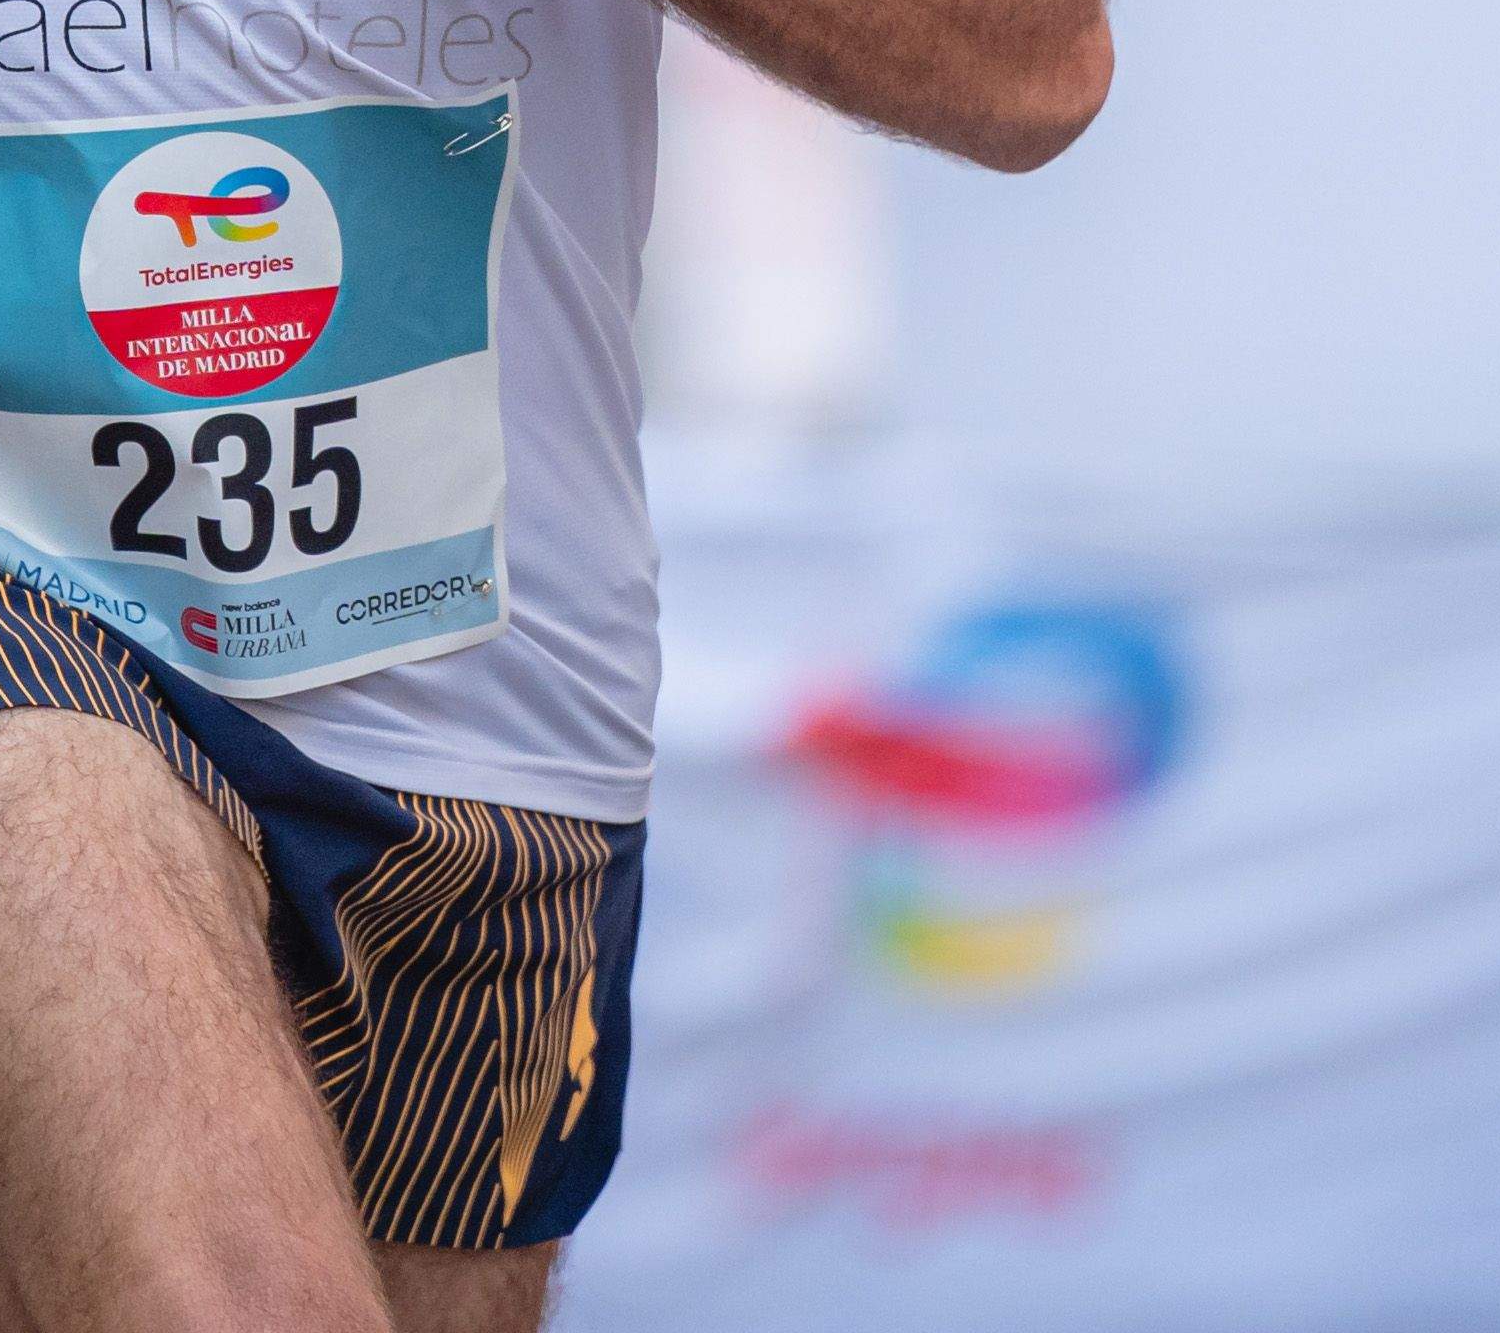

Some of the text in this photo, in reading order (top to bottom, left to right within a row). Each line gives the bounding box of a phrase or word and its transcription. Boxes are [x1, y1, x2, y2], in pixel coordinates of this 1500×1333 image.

[139, 254, 295, 288] TotalEnergies
[180, 304, 255, 330] MILLA
[157, 348, 286, 379] DE MADRID
[91, 395, 362, 573] 235
[15, 559, 148, 625] MADRID
[221, 597, 281, 612] new balance
[224, 608, 296, 635] MILLA
[223, 629, 308, 658] URBANA
